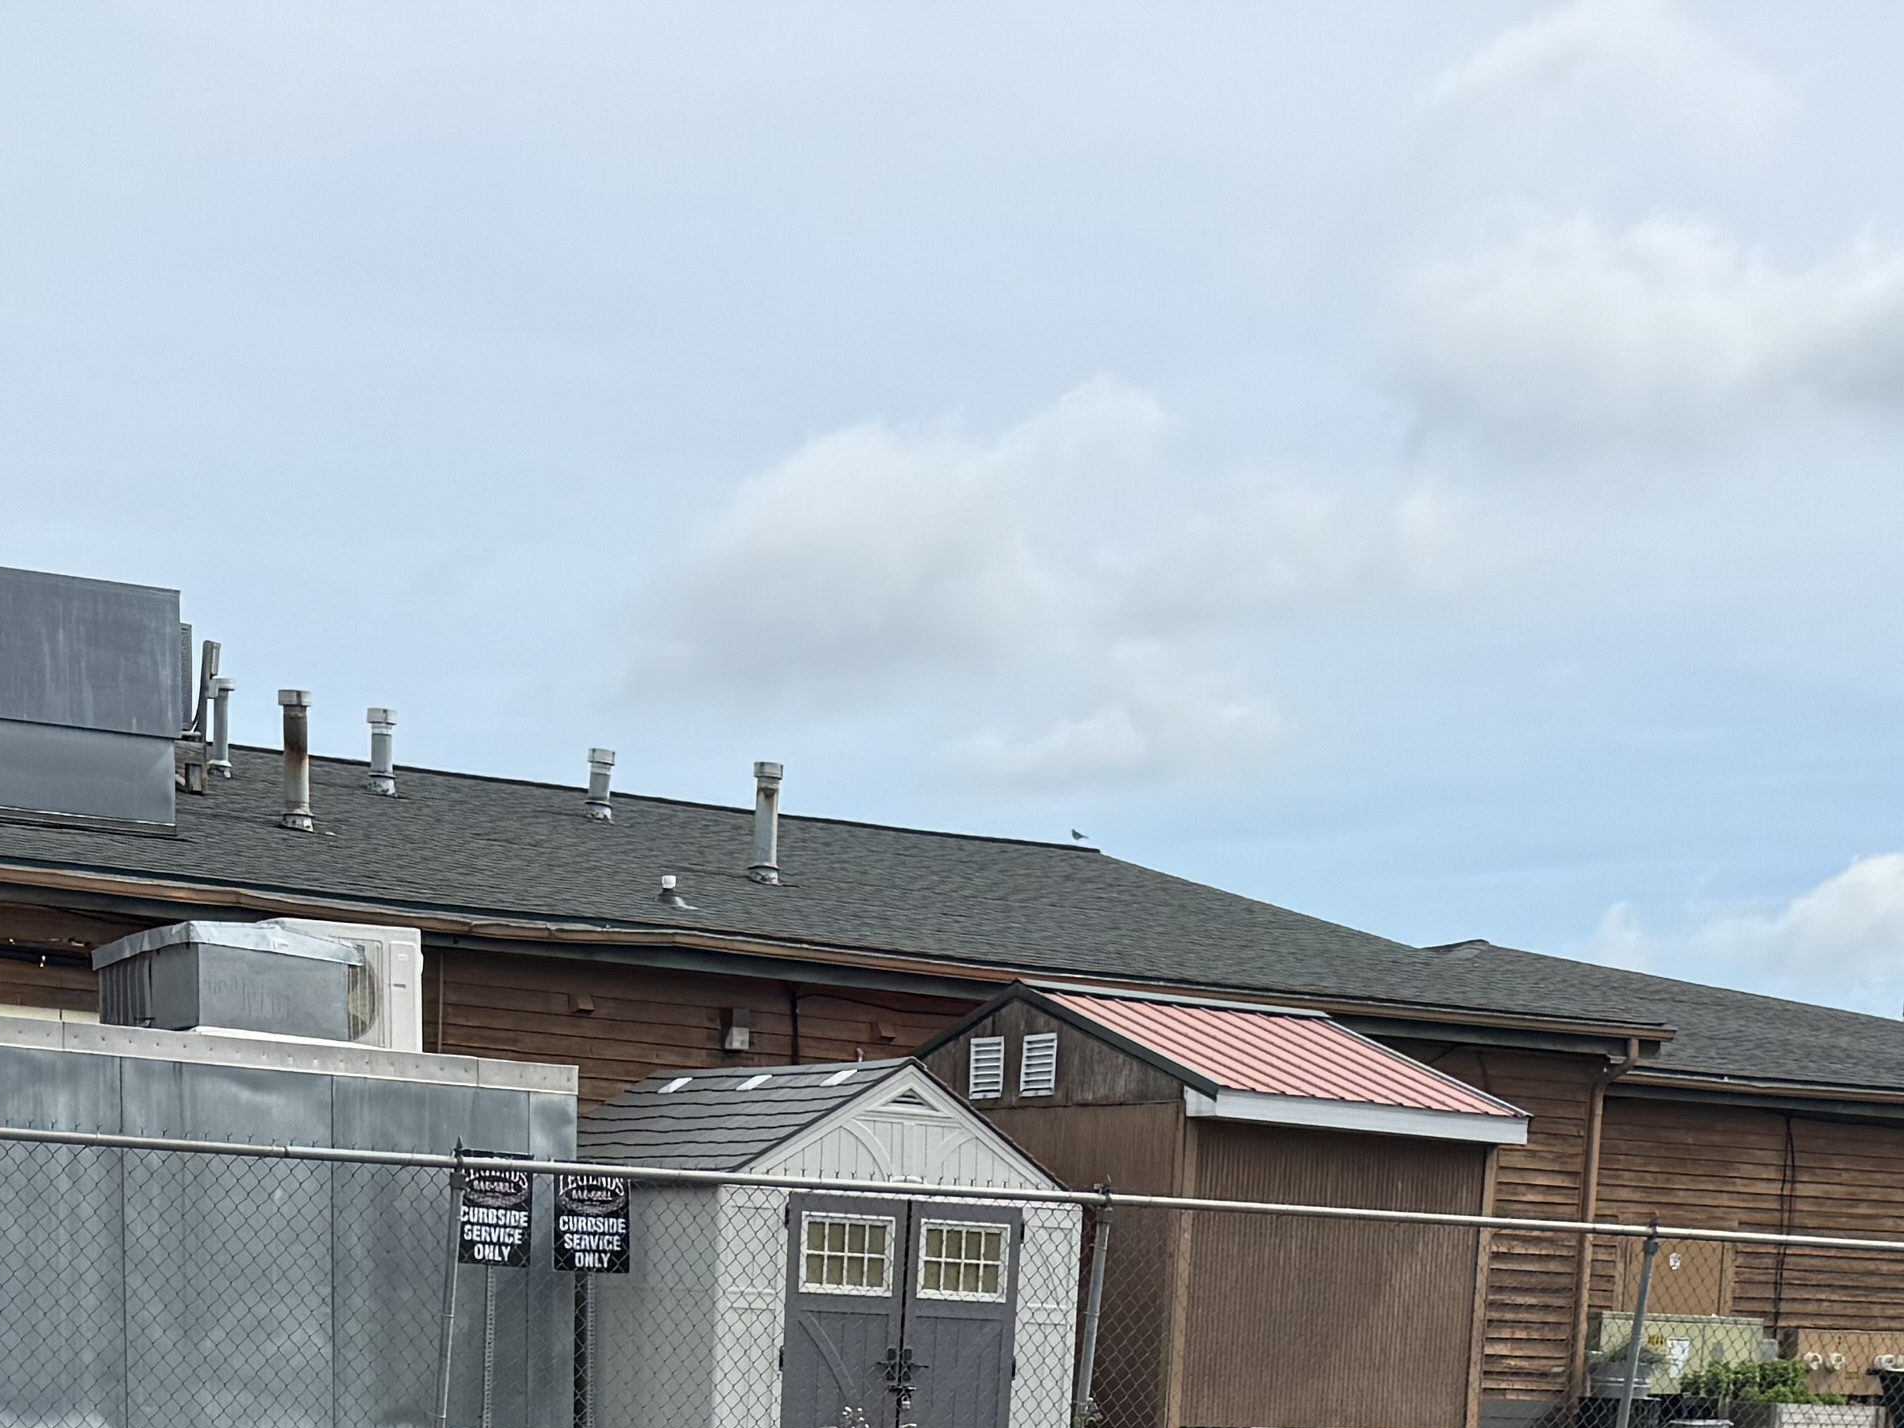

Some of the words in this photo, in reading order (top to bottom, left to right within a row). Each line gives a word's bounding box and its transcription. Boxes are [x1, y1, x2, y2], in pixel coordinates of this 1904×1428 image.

[460, 1205, 529, 1227] CURBSIDE
[559, 1215, 627, 1233] CURBSIDE
[463, 1224, 523, 1245] SERVICE
[563, 1233, 622, 1251] SERVICE
[474, 1243, 512, 1262] ONLY
[574, 1251, 611, 1268] ONLY
